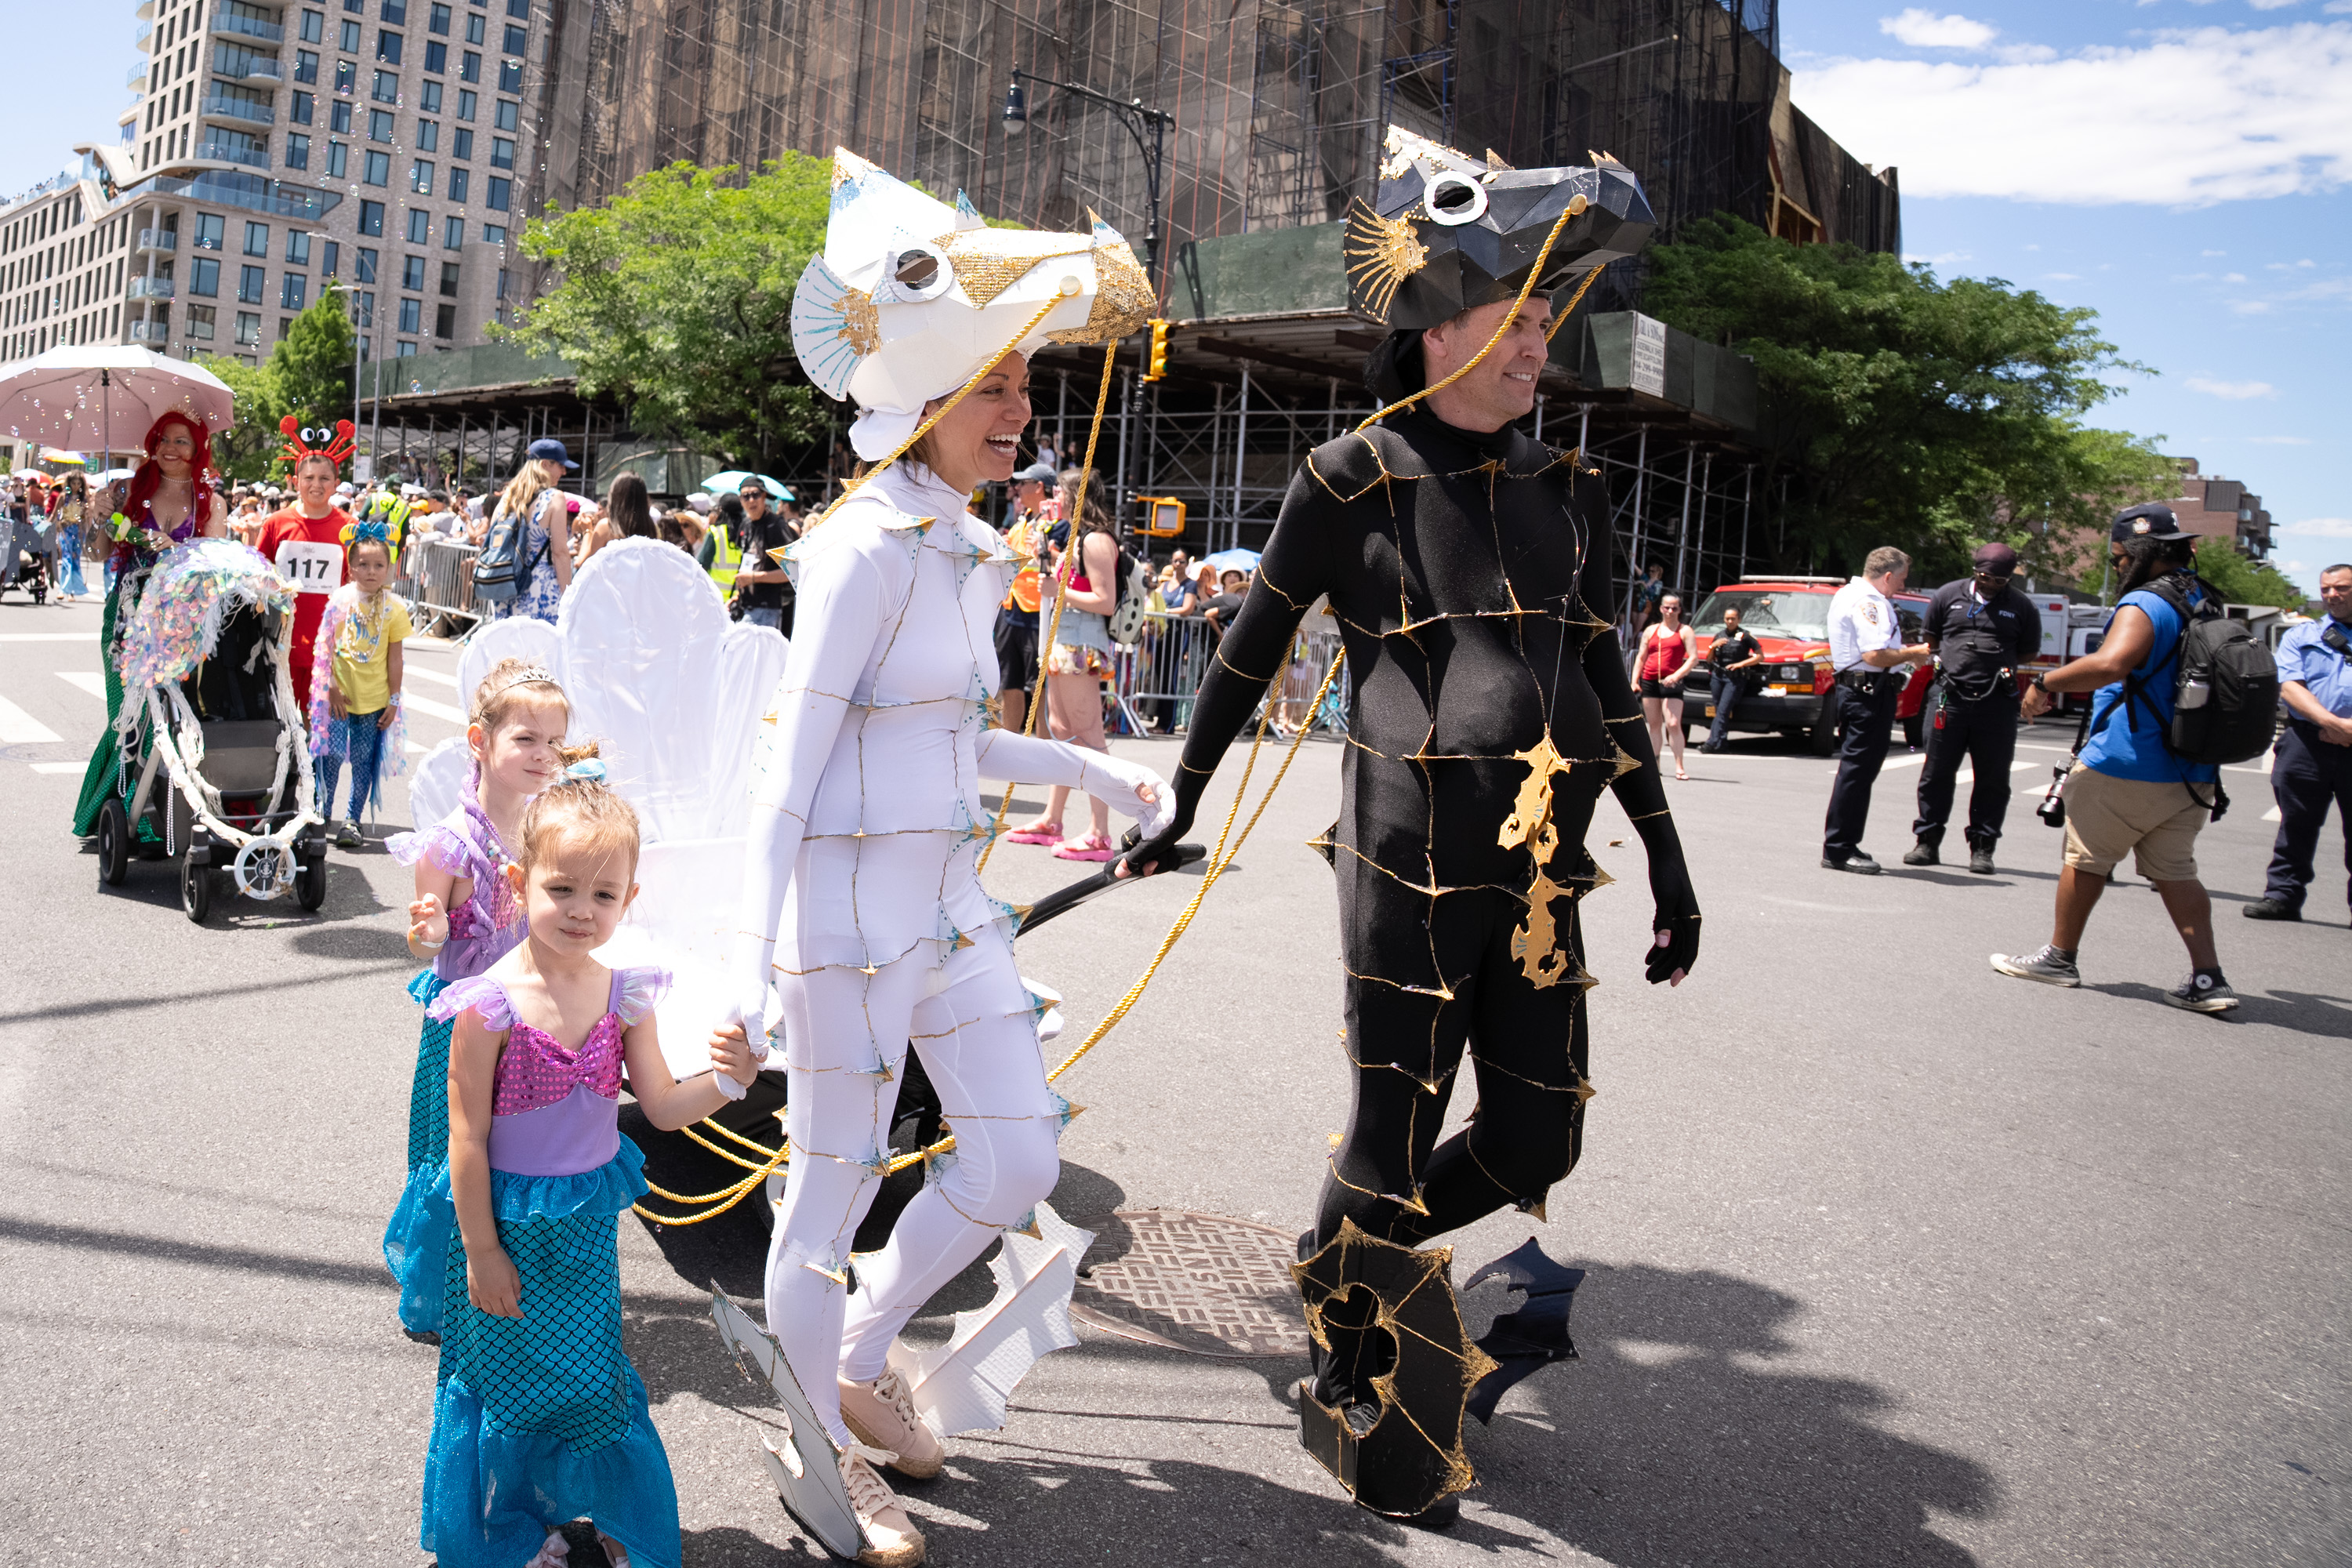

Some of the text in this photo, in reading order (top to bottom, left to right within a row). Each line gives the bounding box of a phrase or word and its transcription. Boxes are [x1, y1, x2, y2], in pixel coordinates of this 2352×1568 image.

[288, 557, 329, 579] 117
[1998, 610, 2016, 619] FDNY
[1226, 1231, 1269, 1265] INDIA
